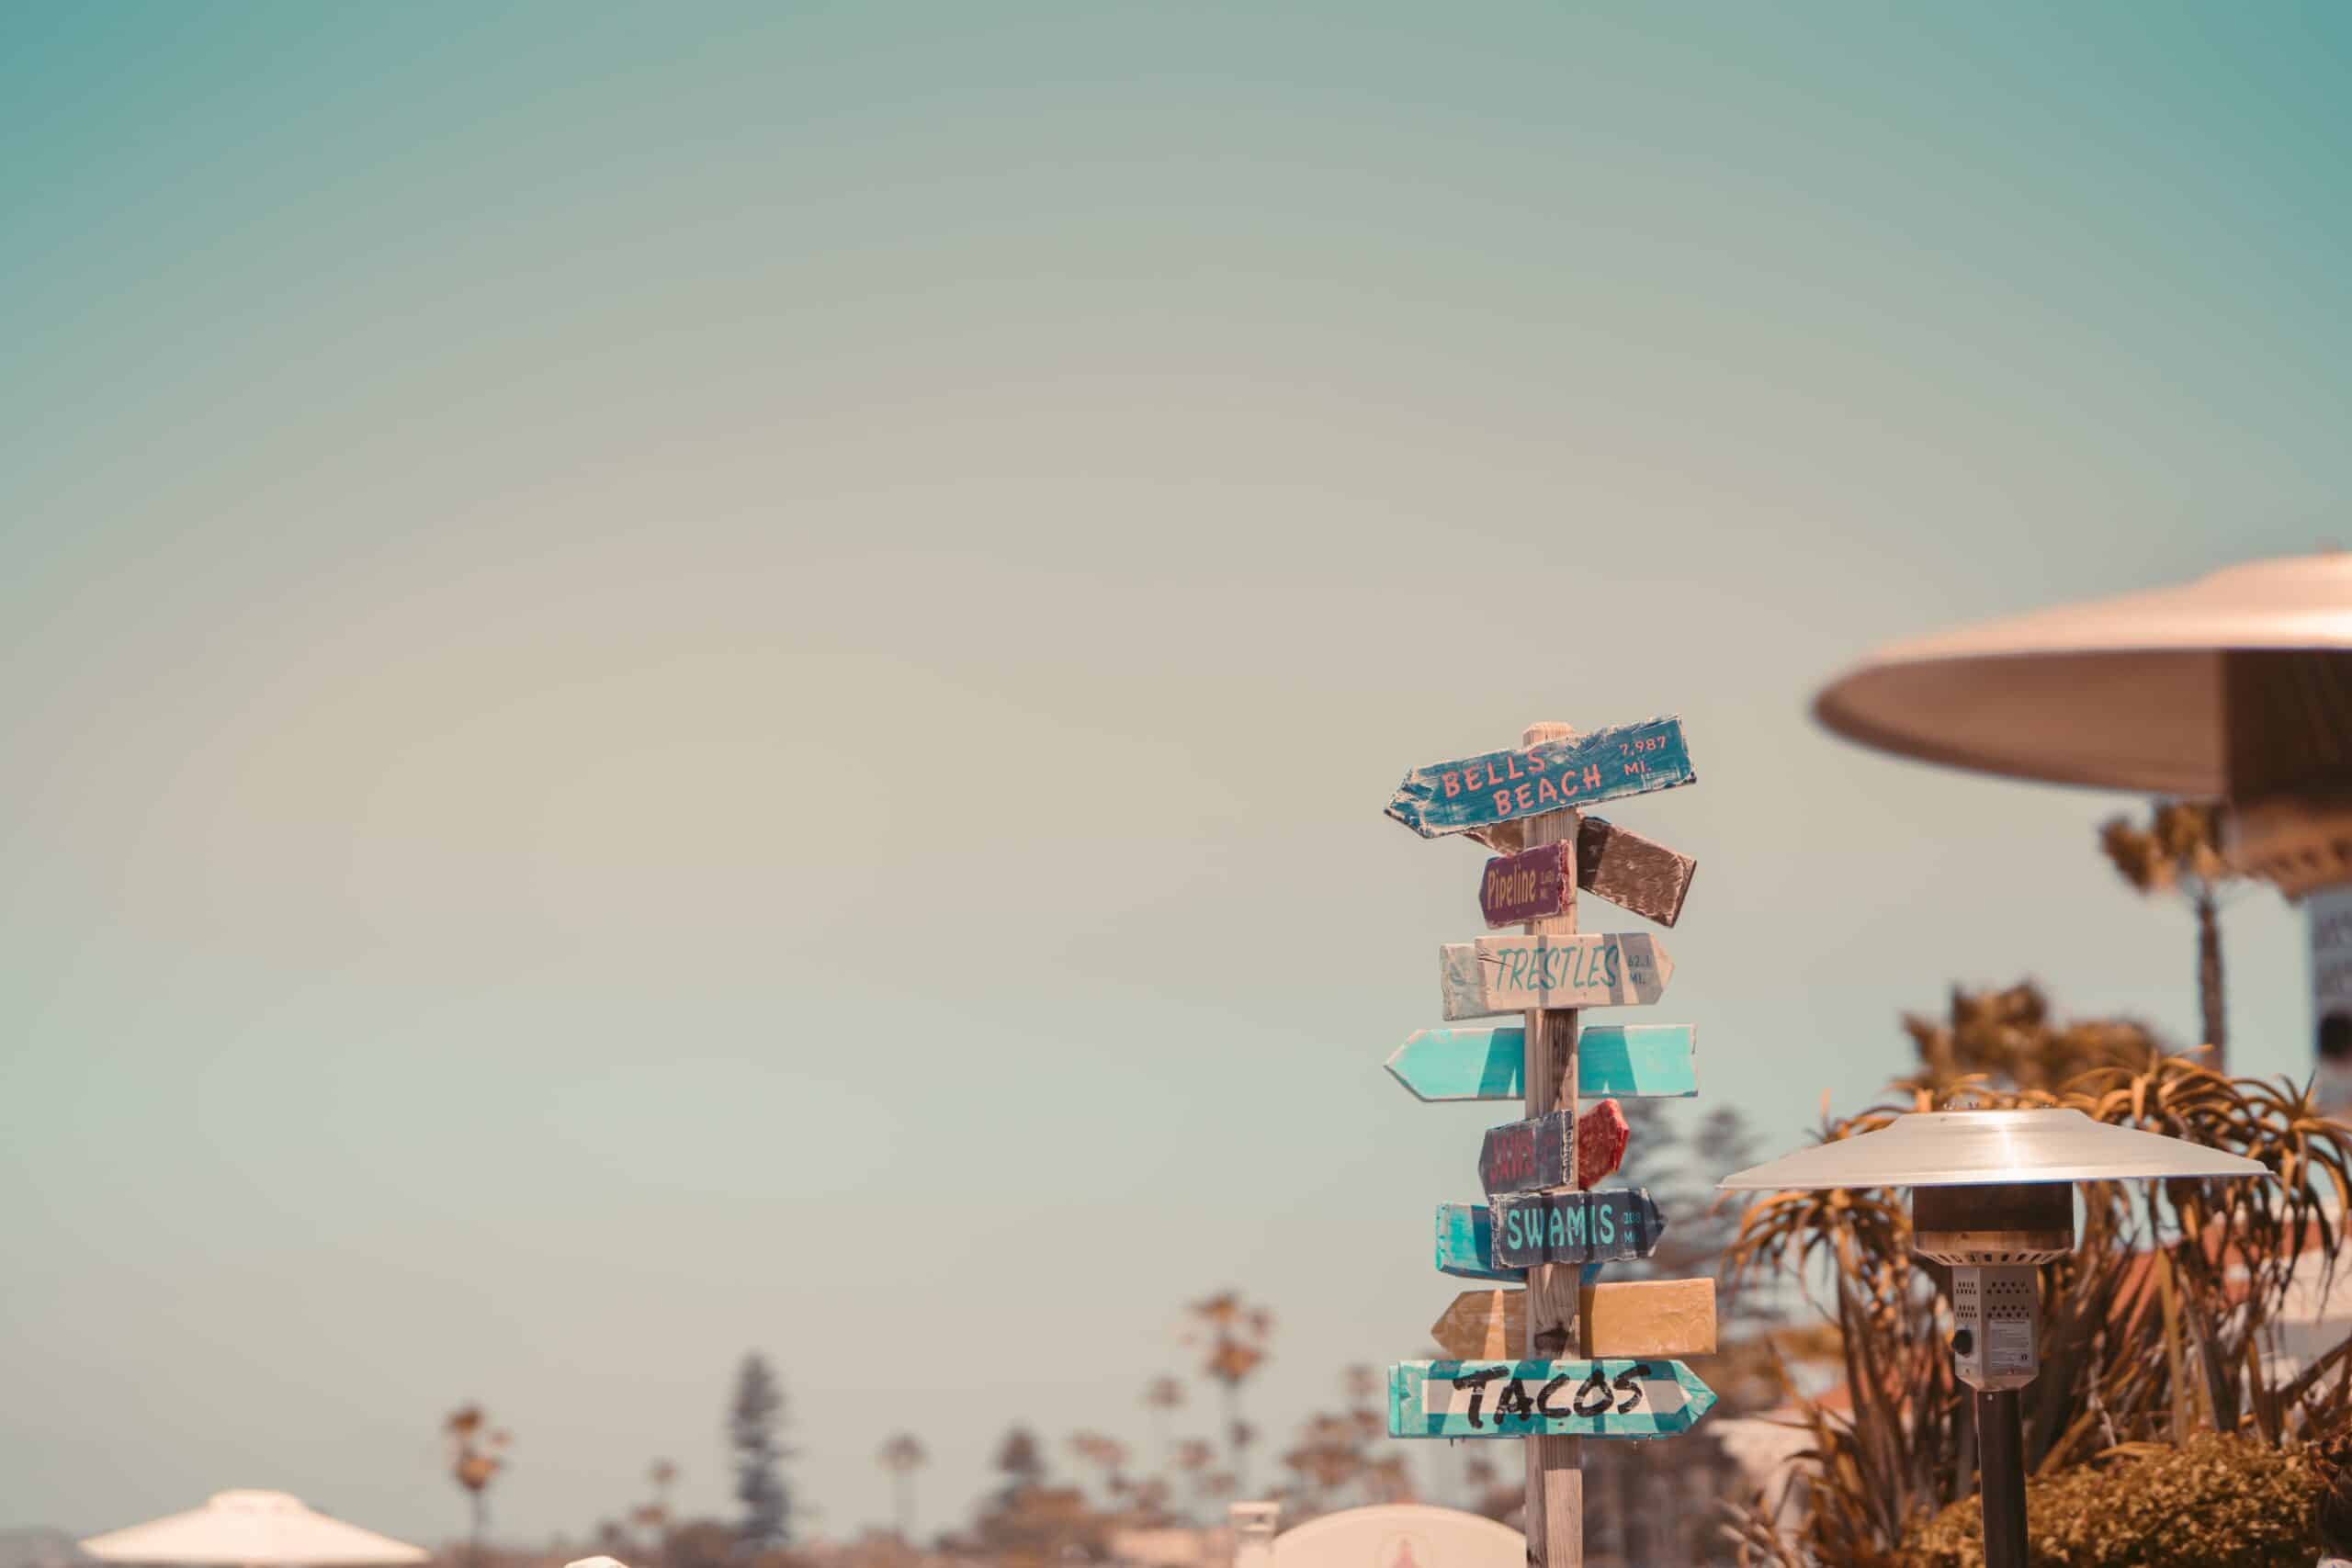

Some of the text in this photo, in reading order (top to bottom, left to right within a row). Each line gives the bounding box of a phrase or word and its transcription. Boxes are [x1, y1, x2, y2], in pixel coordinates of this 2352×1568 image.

[1619, 735, 1666, 756] 7,987
[1442, 749, 1546, 797] BELLS
[1493, 764, 1602, 817] BEACH
[1487, 863, 1536, 911] Pipeline
[1496, 944, 1620, 992] TRESTLES
[1506, 1204, 1615, 1250] SWAMIS
[1453, 1365, 1652, 1428] TACOS
